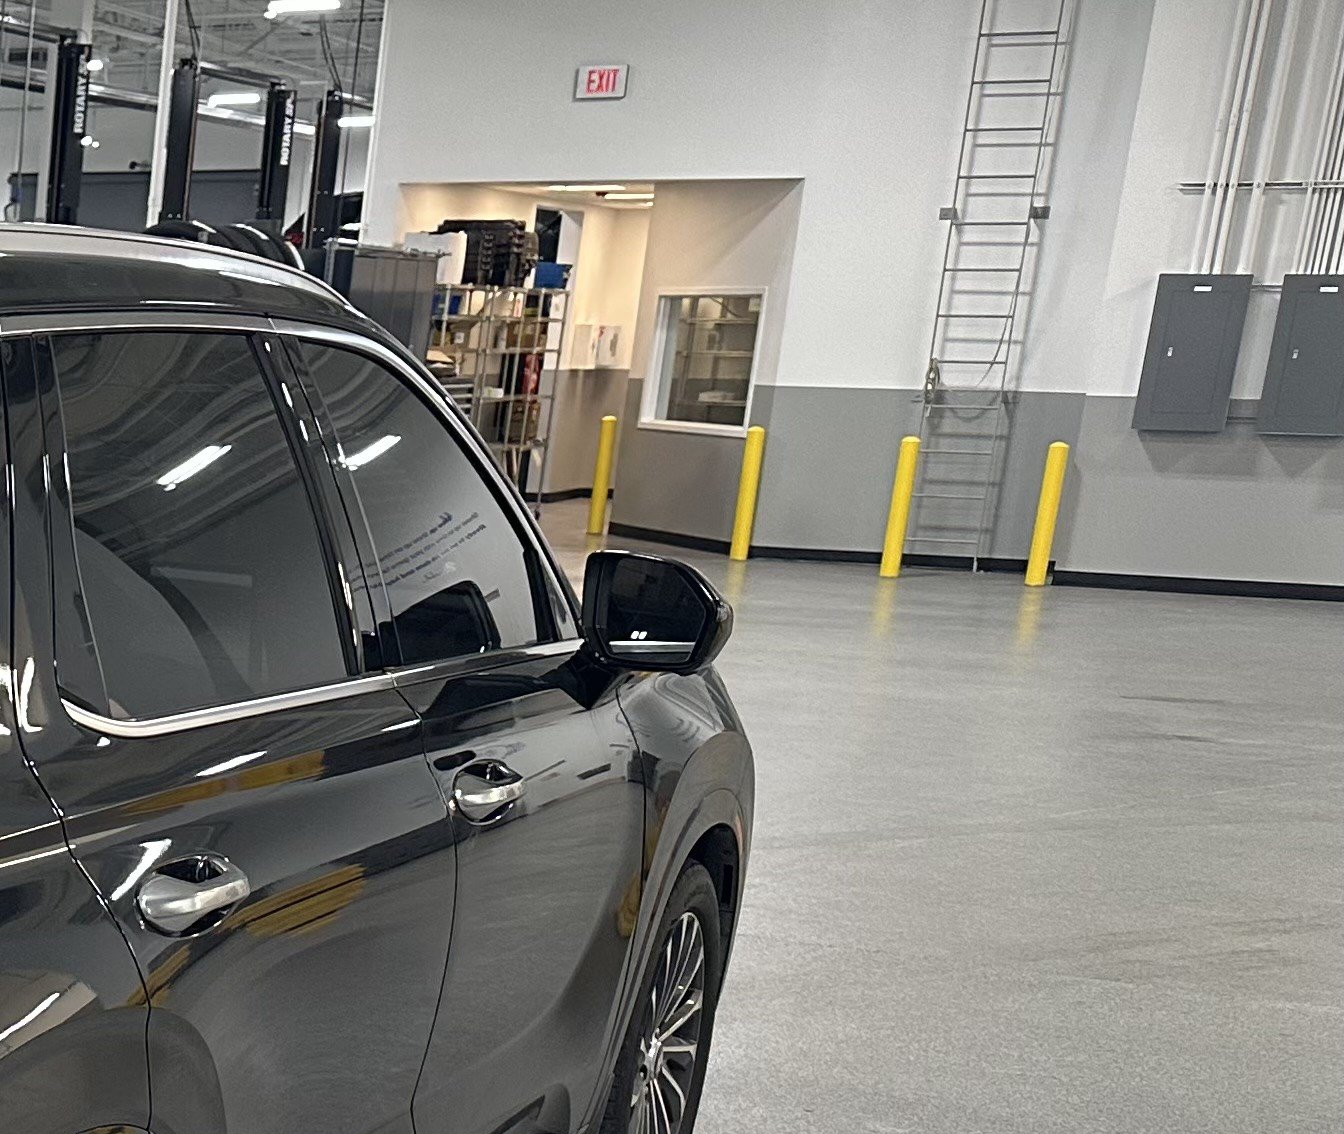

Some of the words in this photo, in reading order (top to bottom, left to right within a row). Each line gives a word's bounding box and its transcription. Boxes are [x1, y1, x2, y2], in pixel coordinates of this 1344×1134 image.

[73, 76, 87, 133] ROTARY
[585, 68, 620, 93] EXIT
[280, 116, 293, 165] ROTARY
